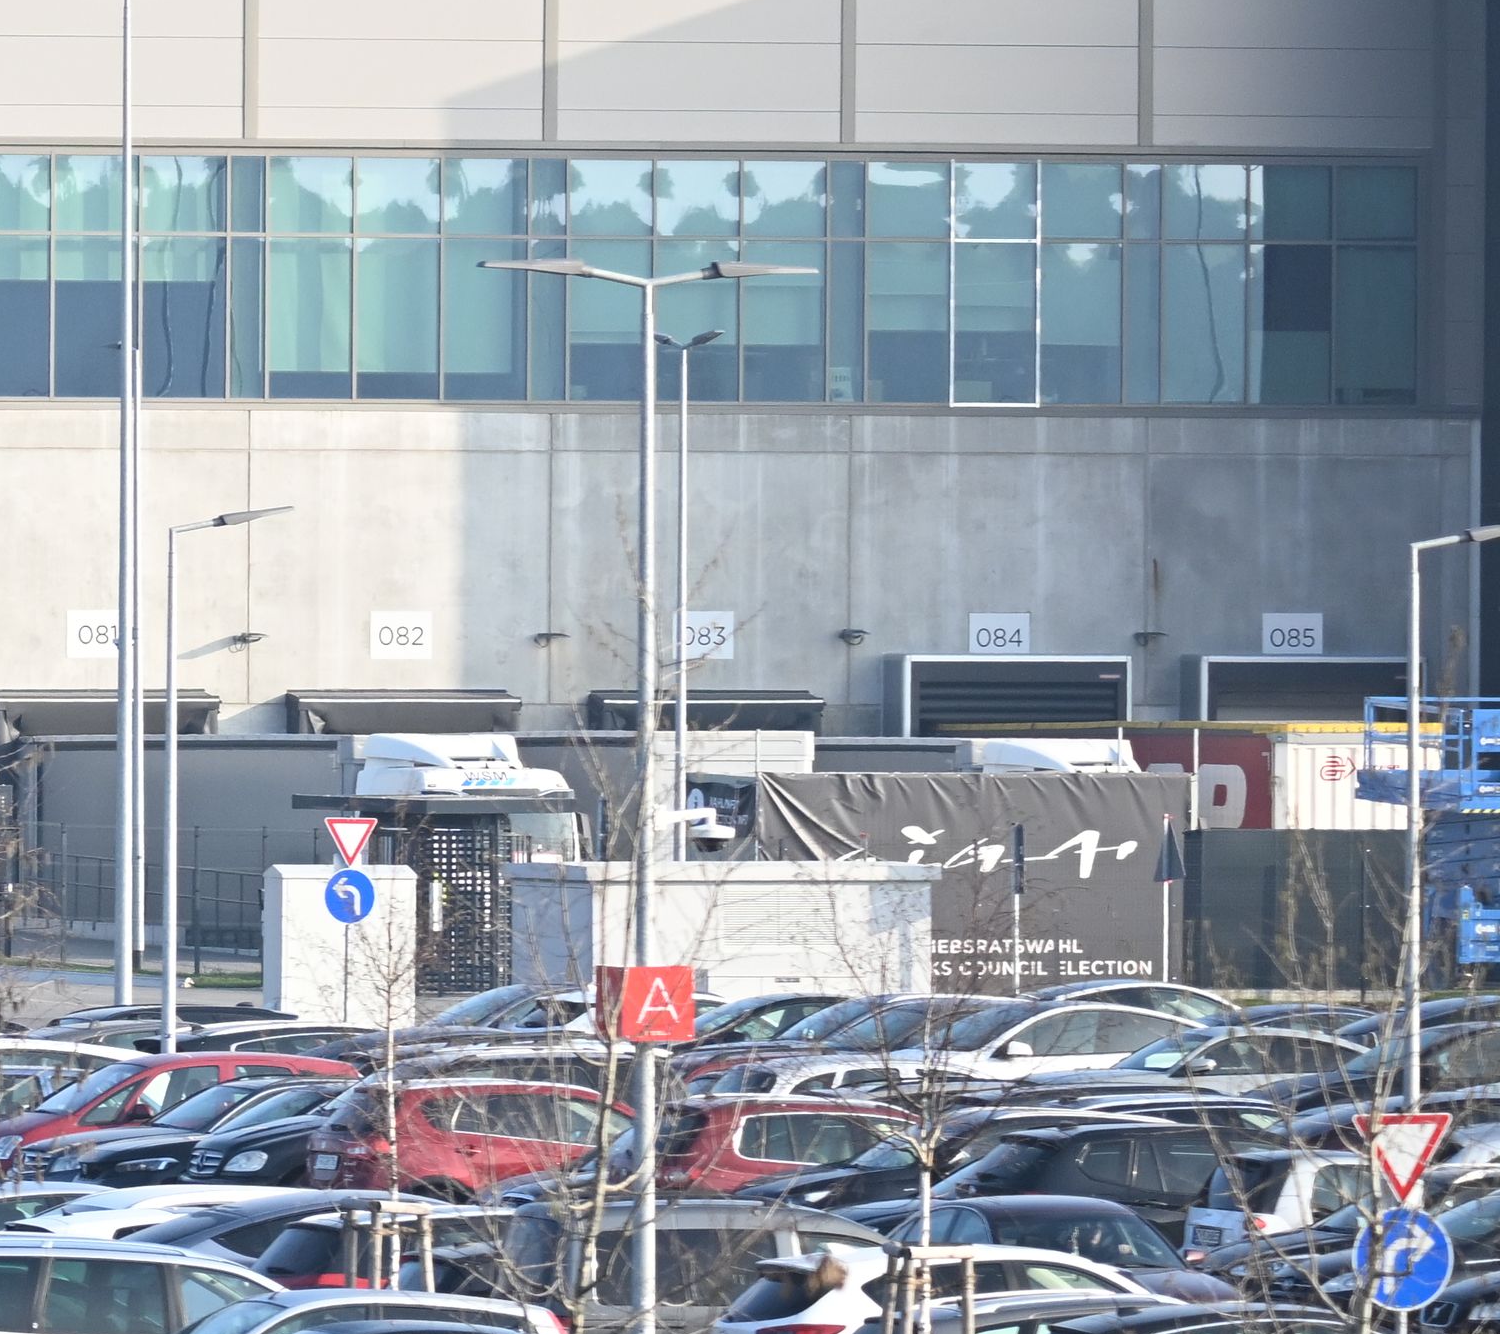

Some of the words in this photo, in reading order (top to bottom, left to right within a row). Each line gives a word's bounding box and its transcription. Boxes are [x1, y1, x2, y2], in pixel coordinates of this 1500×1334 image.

[78, 625, 117, 644] 081
[379, 626, 424, 646] 082
[686, 626, 726, 646] 083
[976, 628, 1023, 648] 084
[1270, 628, 1316, 648] 085
[1059, 960, 1153, 975] ELECTION
[636, 977, 680, 1024] A
